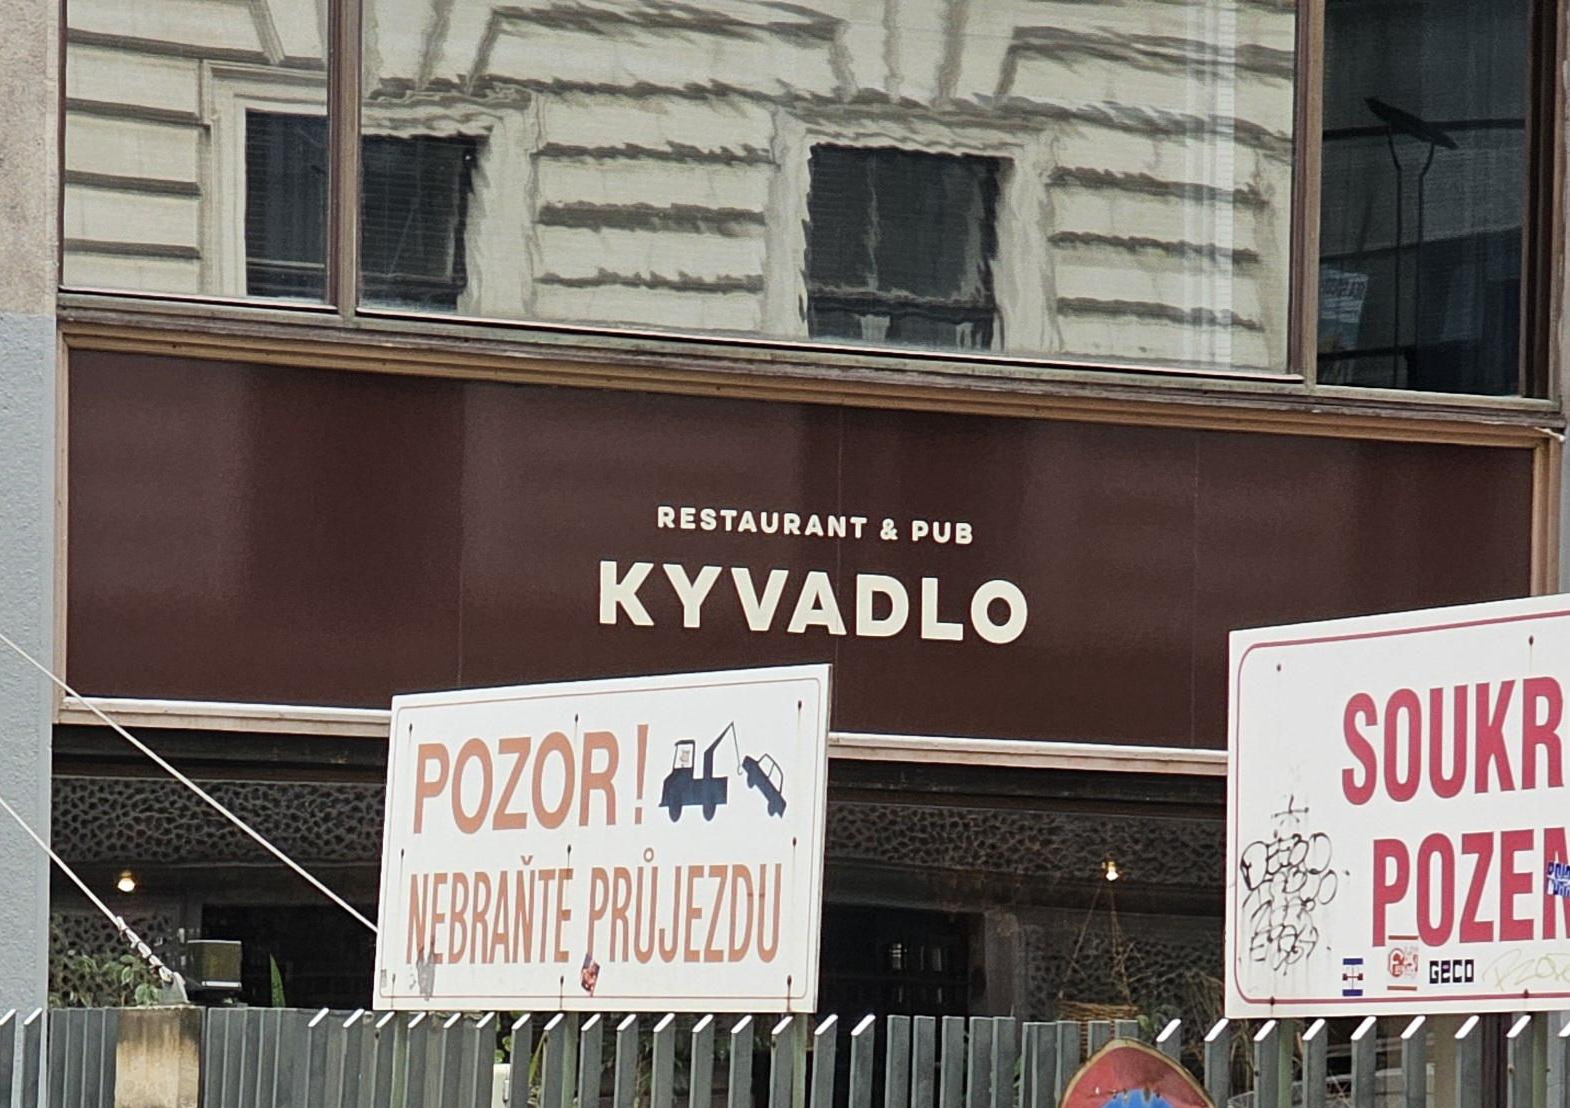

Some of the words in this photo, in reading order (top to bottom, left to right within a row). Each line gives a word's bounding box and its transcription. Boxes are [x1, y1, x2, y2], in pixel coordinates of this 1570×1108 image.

[657, 506, 868, 539] RESTAURANT
[880, 519, 899, 541] &
[912, 521, 974, 545] PUB
[598, 560, 1028, 645] KYVADLO
[1341, 676, 1565, 805] SOUKR
[405, 854, 573, 965] NEBRAŇTE
[588, 847, 782, 964] PRŮJEZDU
